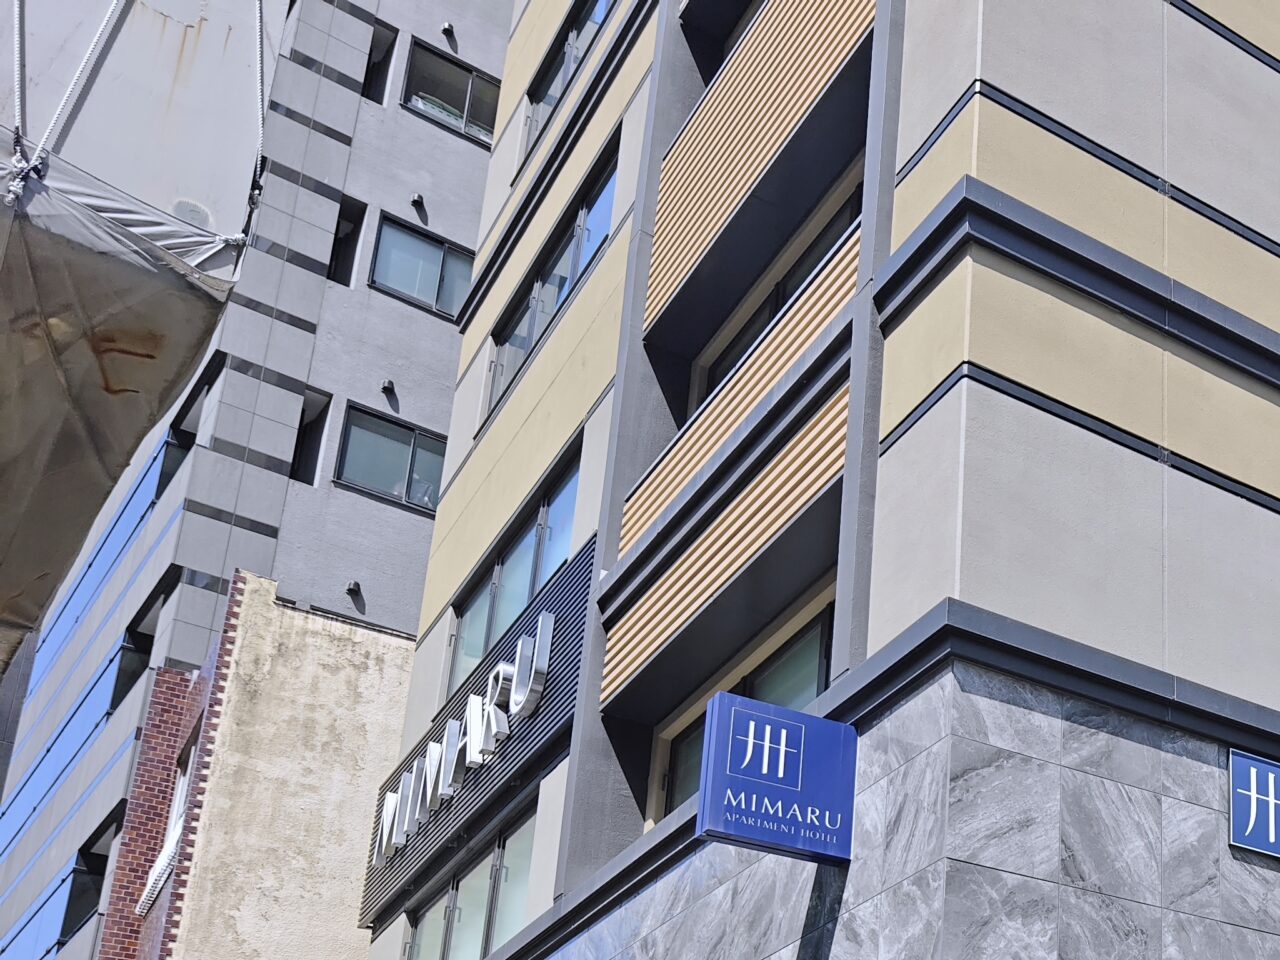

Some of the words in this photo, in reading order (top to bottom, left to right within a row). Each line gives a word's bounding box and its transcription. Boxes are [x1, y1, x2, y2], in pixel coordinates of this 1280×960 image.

[373, 610, 555, 868] MIMARU
[723, 811, 795, 835] APARTMENT
[801, 828, 837, 844] HOTEL
[724, 787, 842, 830] MIMARU
